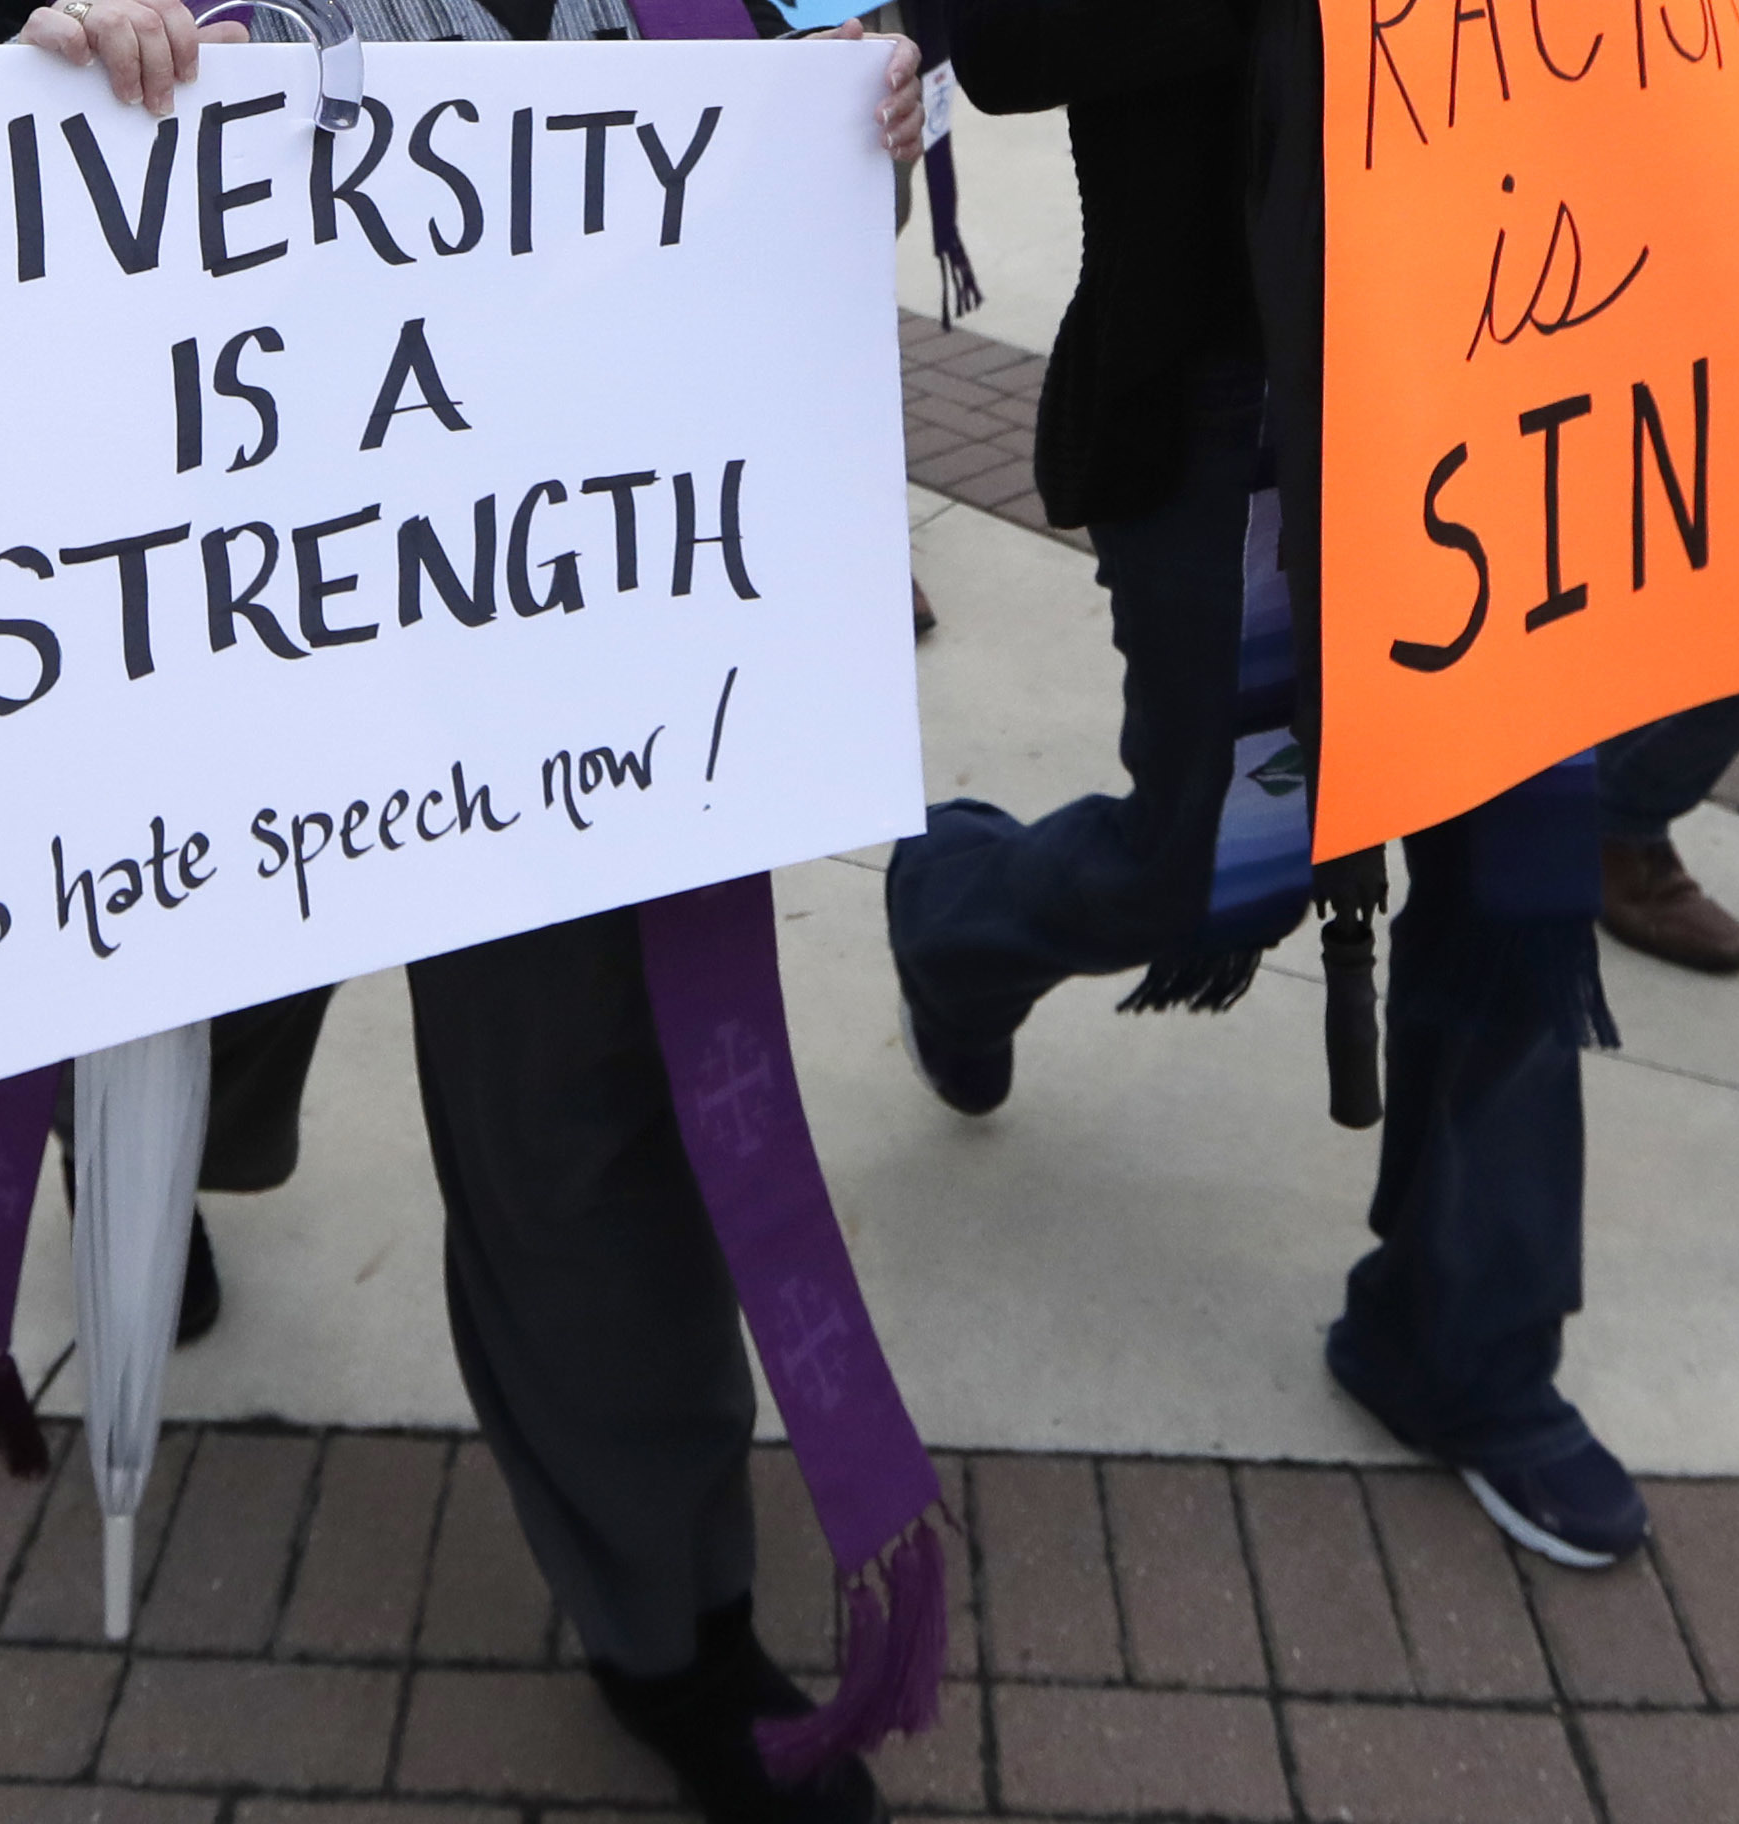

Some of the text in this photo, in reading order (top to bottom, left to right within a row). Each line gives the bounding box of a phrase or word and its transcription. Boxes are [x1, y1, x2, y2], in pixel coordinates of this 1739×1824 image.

[1466, 173, 1650, 362] is
[171, 317, 472, 475] IS A
[51, 815, 217, 958] hate
[251, 760, 521, 921] speech
